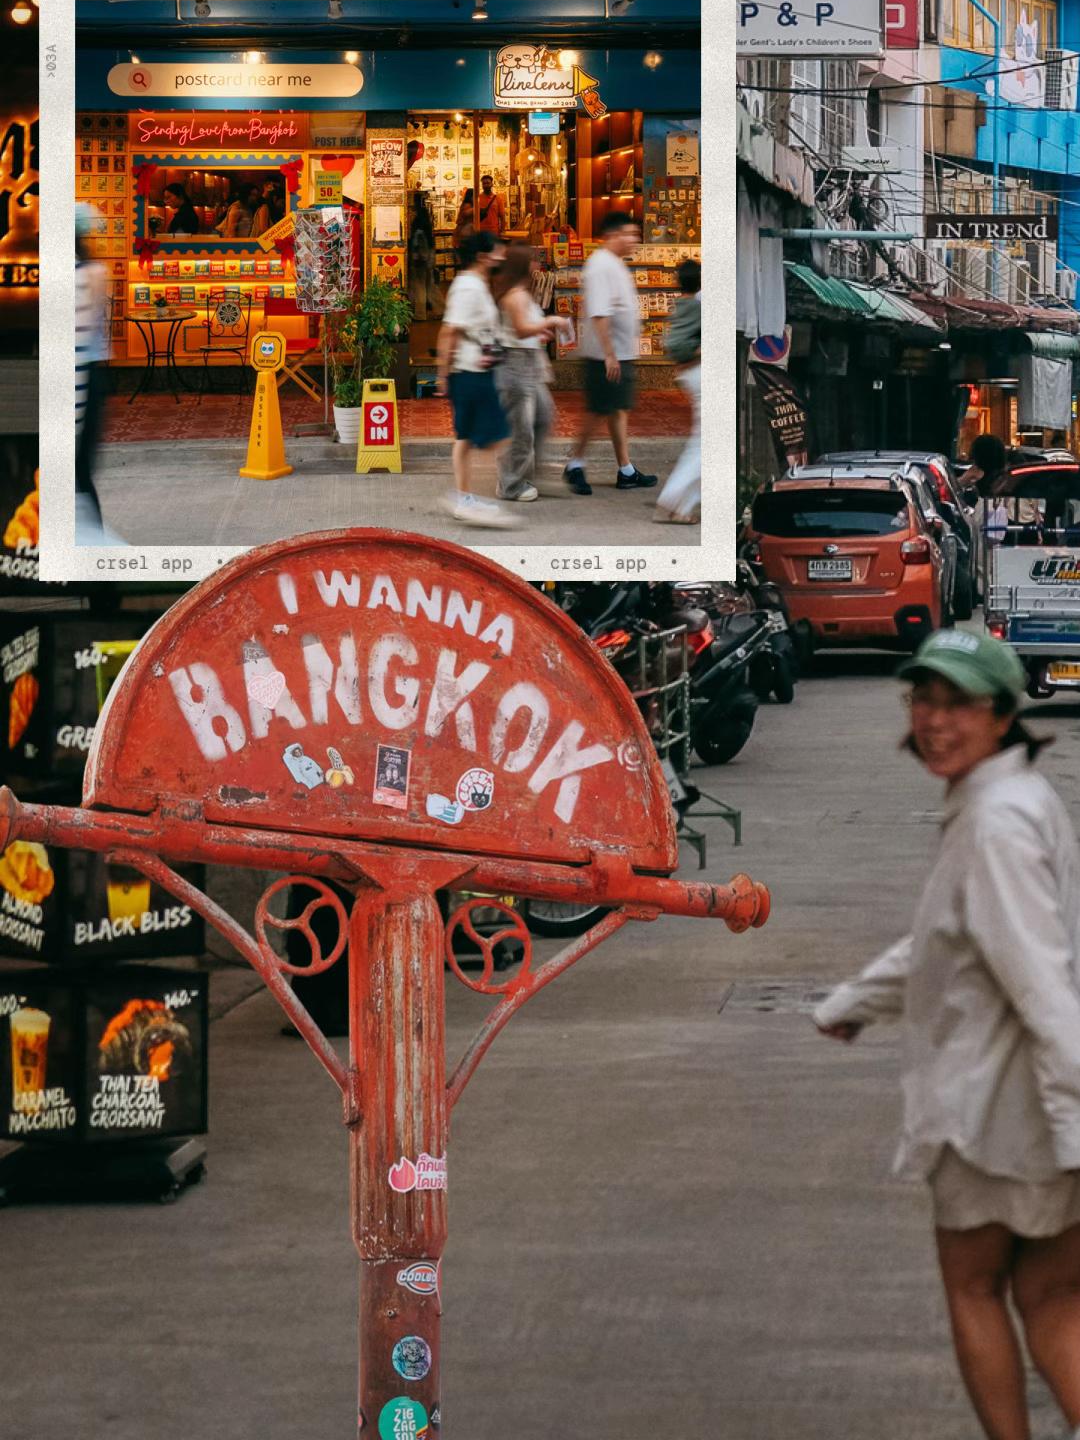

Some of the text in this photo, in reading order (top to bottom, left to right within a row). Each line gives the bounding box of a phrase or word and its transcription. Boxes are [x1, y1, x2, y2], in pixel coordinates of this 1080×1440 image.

[740, 1, 835, 27] P & P
[175, 72, 312, 89] postcard near me
[314, 136, 363, 147] POST HERE
[372, 142, 403, 152] MEOW
[935, 222, 965, 239] IN
[771, 411, 807, 428] COFFEE
[370, 426, 388, 440] IN
[277, 568, 516, 657] I WANNA
[167, 630, 614, 824] BANGKOK
[74, 904, 193, 946] BLACK BLISS
[99, 1074, 160, 1093] THAI TEA
[92, 1093, 164, 1110] CHARCOAL
[90, 1109, 166, 1129] CROISSANT
